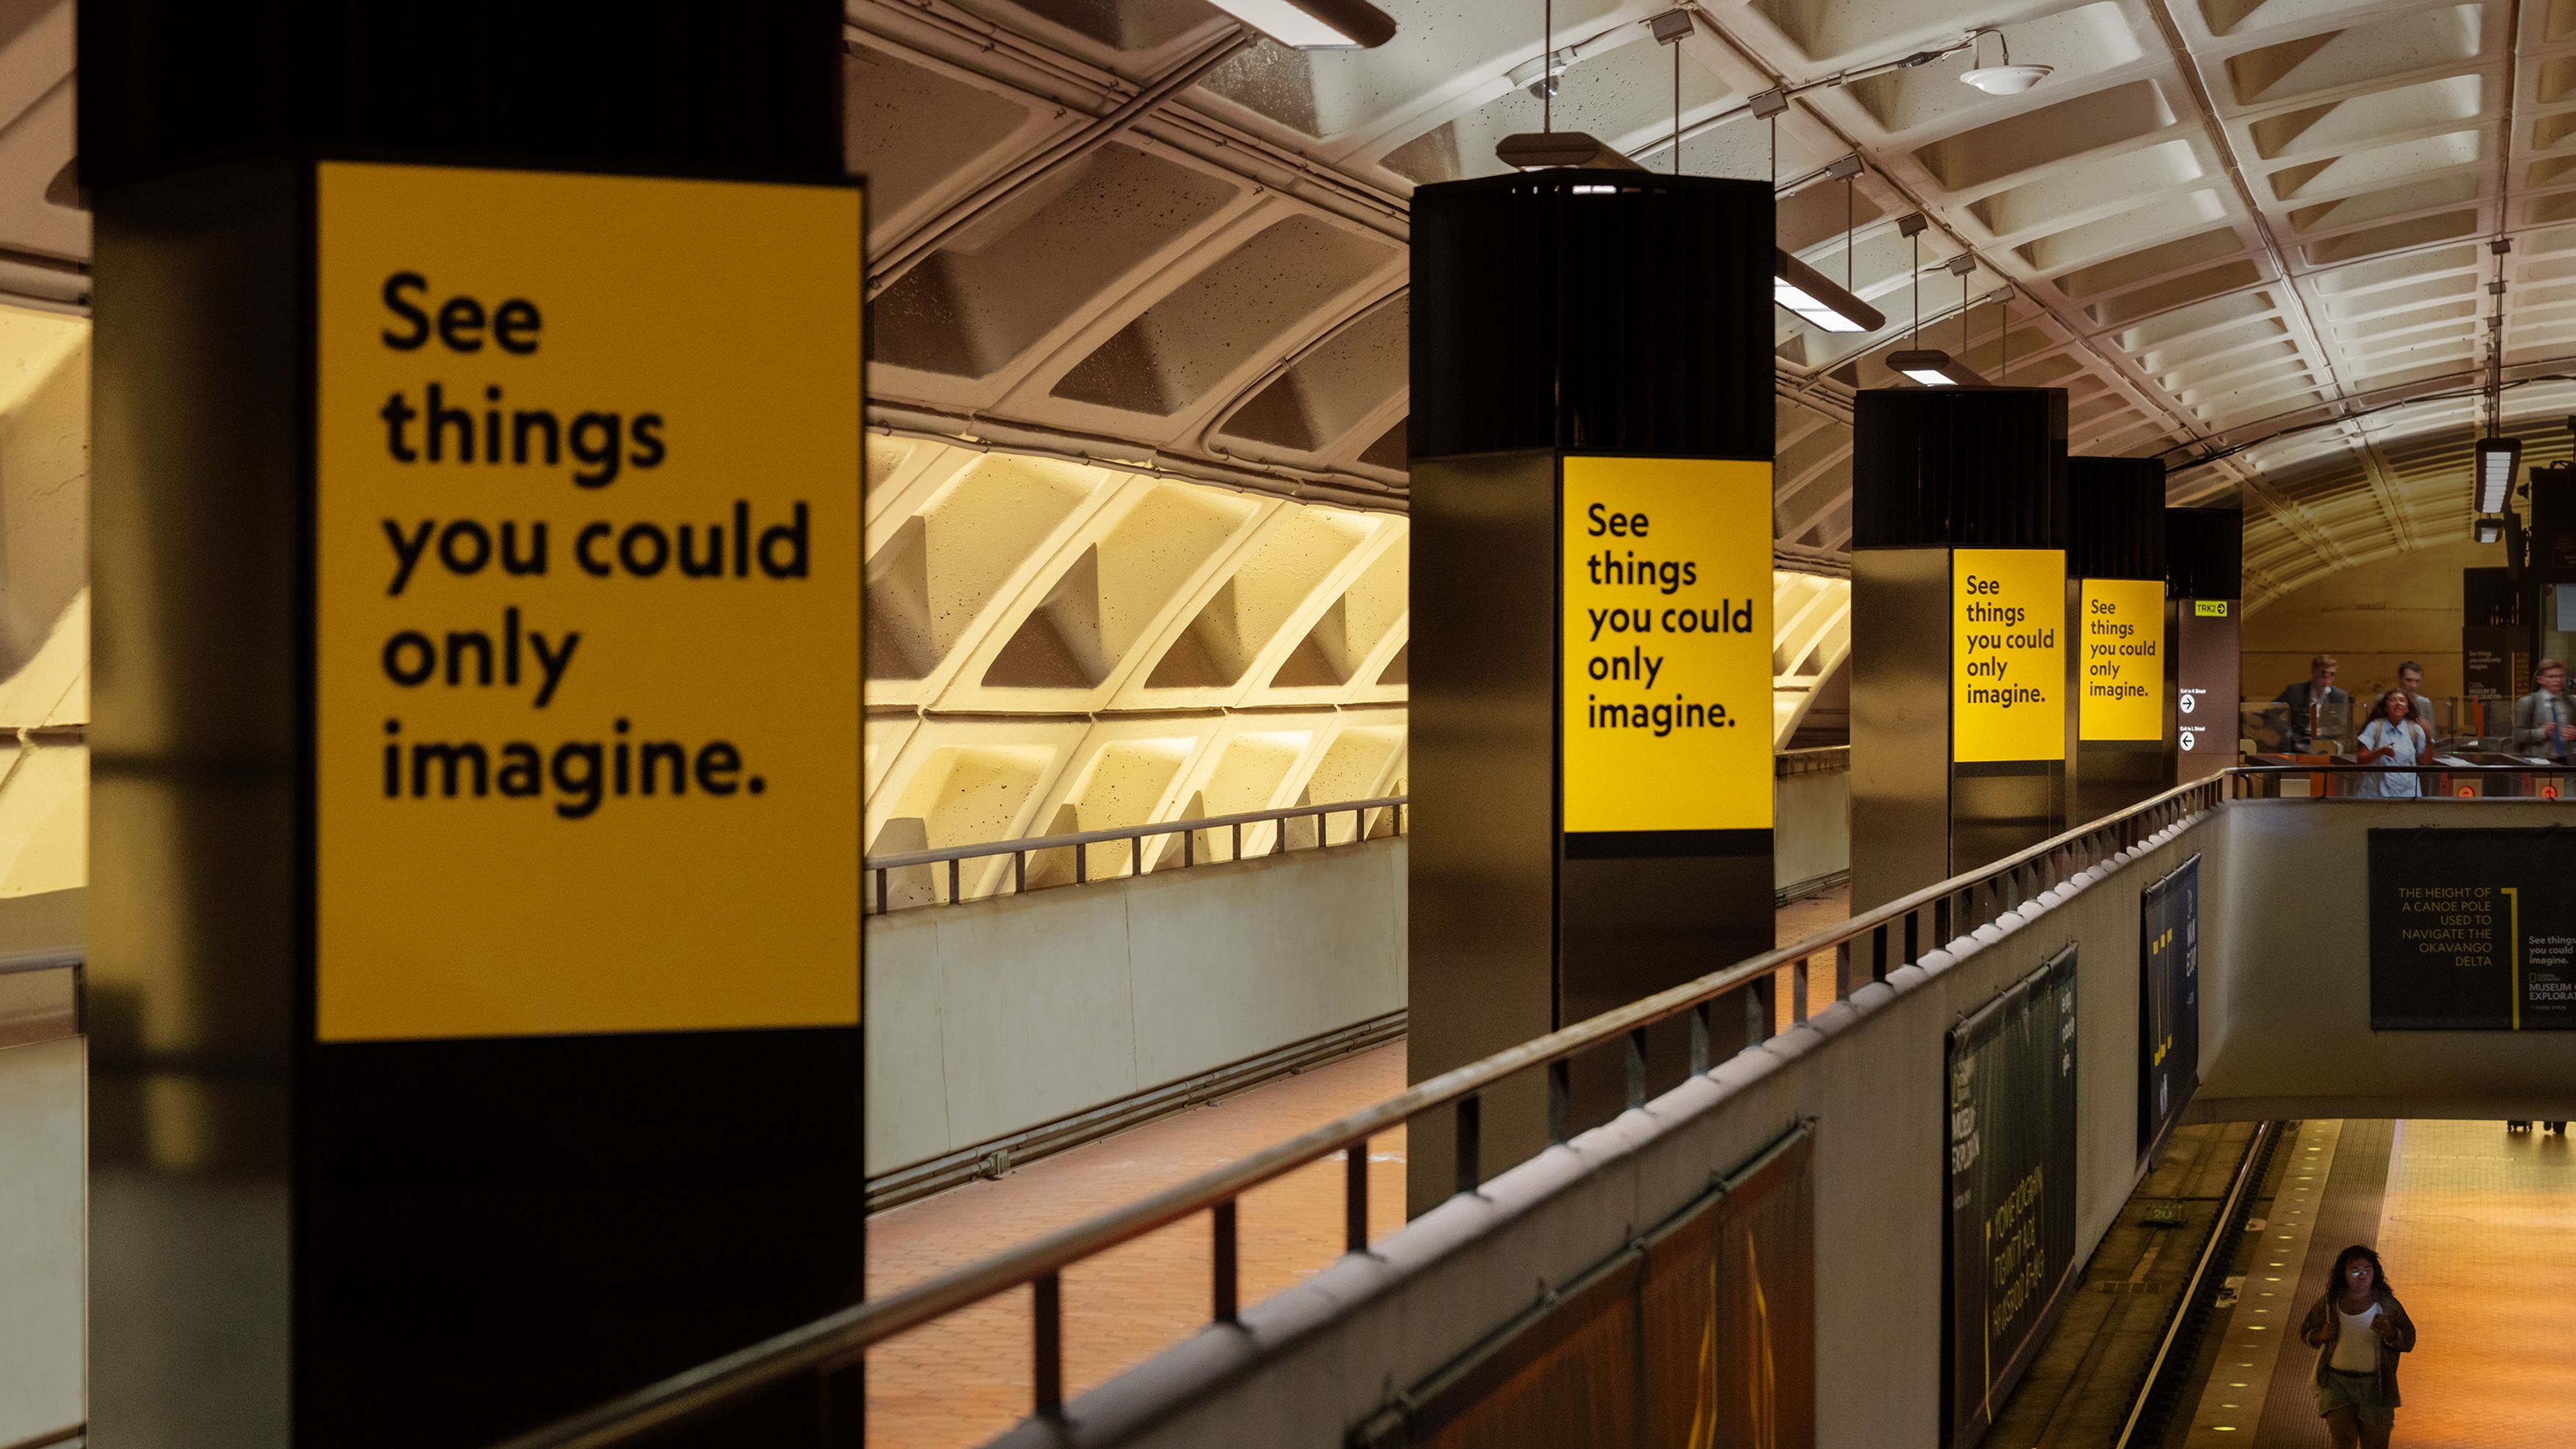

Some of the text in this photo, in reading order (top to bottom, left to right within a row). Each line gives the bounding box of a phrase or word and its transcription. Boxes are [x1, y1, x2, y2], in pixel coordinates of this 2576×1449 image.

[380, 269, 545, 358] See
[378, 380, 668, 492] things
[1588, 503, 1649, 538] See
[380, 497, 812, 598] you could
[1588, 550, 1696, 595] things
[1967, 575, 2000, 595] See
[1967, 602, 2025, 627] things
[2091, 599, 2115, 614] See
[2197, 604, 2216, 612] TRK2
[1588, 598, 1752, 642] you could
[2091, 620, 2134, 639] things
[1967, 628, 2054, 654] you could
[2090, 641, 2156, 659] you could
[380, 604, 583, 711] only
[1588, 645, 1663, 690] only
[1967, 656, 2008, 681] only
[2090, 661, 2120, 679] only
[1967, 684, 2045, 709] imagine.
[2090, 681, 2148, 700] imagine.
[1589, 694, 1735, 737] imagine.
[382, 716, 768, 822] imagine.
[2399, 888, 2491, 898] THE HEIGHT OF
[2402, 901, 2491, 912] A CANOE POLE
[2440, 915, 2492, 925] USED TO
[2402, 929, 2491, 939] NAVIGATE THE
[2528, 935, 2576, 946] See things
[2419, 942, 2493, 953] OKAVANGO
[2528, 947, 2547, 956] you
[2548, 945, 2574, 954] could
[2455, 956, 2493, 966] DELTA
[2529, 955, 2569, 966] imagine.
[2529, 982, 2572, 991] MUSEUM
